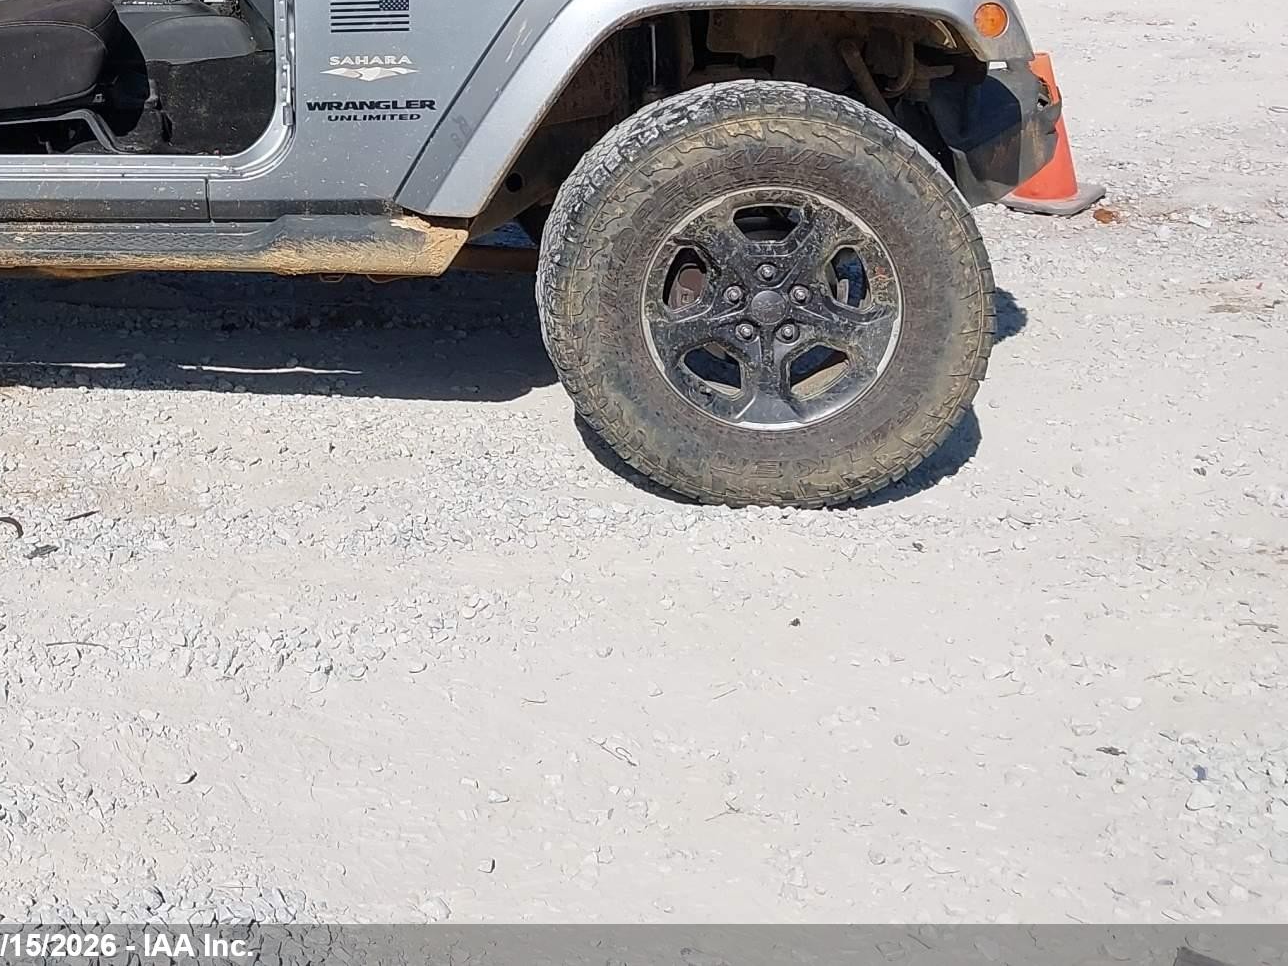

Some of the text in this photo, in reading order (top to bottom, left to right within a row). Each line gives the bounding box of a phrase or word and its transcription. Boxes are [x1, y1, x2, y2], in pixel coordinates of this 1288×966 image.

[329, 55, 413, 66] SAHARA
[306, 99, 437, 111] WRANGLER
[328, 113, 421, 122] UNLIMITED
